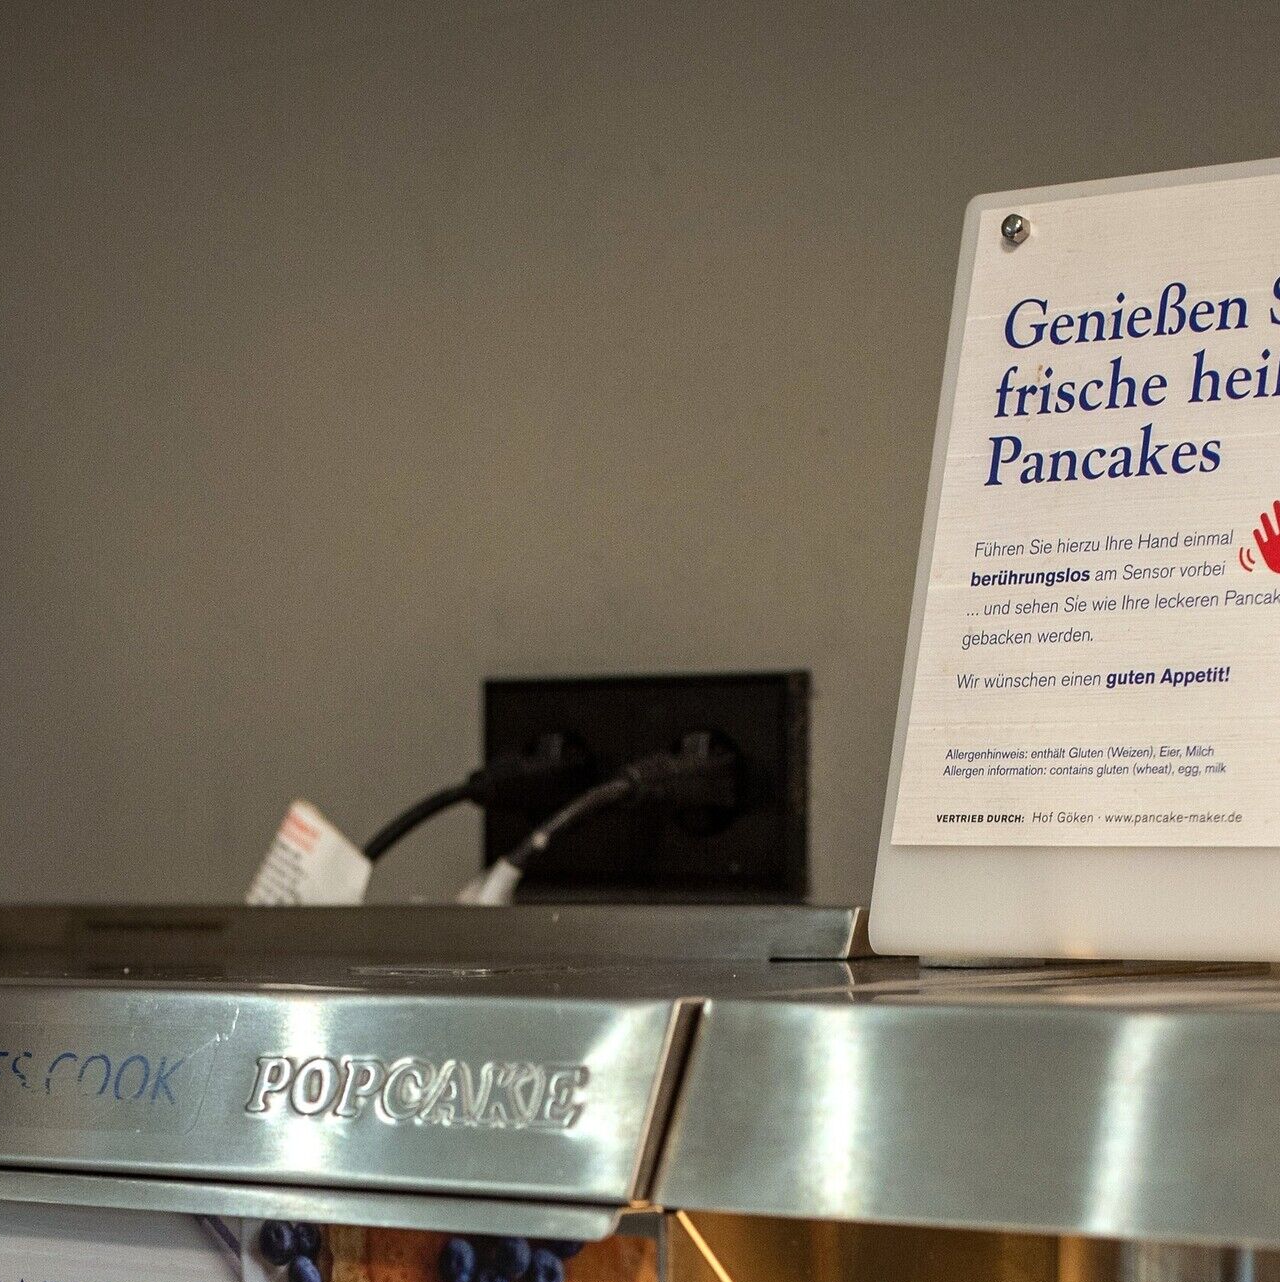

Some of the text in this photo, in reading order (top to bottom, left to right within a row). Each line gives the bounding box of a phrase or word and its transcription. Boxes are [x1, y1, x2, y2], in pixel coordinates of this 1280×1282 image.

[1005, 282, 1248, 349] Genießen
[994, 355, 1168, 418] frische
[984, 423, 1221, 486] Pancakes
[974, 530, 1233, 558] Führen Sie hierzu Ihre Hand einmal
[970, 561, 1226, 587] berührungslos am Sensor vorbei
[983, 601, 1009, 616] und
[1014, 600, 1058, 615] sehen
[1063, 597, 1088, 612] Sie
[1092, 596, 1117, 611] wie
[1122, 594, 1149, 611] Ihre
[1154, 593, 1219, 608] leckeren
[962, 627, 1094, 650] gebacken werden.
[956, 666, 1230, 689] Wir wünschen einen guten Appetit!
[946, 749, 1028, 762] Allergenhinweis:
[1031, 747, 1066, 759] enthält
[1069, 747, 1103, 759] Gluten
[1160, 746, 1182, 758] Eier,
[1186, 746, 1214, 757] Milch
[943, 765, 984, 778] Allergen
[987, 765, 1046, 776] information:
[1050, 765, 1093, 776] contains
[1097, 765, 1128, 778] gluten
[1178, 765, 1201, 777] egg,
[1205, 762, 1226, 773] milk
[936, 811, 1242, 826] VERTRIEB DURCH: Hof Göken www.pancake-maker.de
[245, 1056, 590, 1127] POPCAKE
